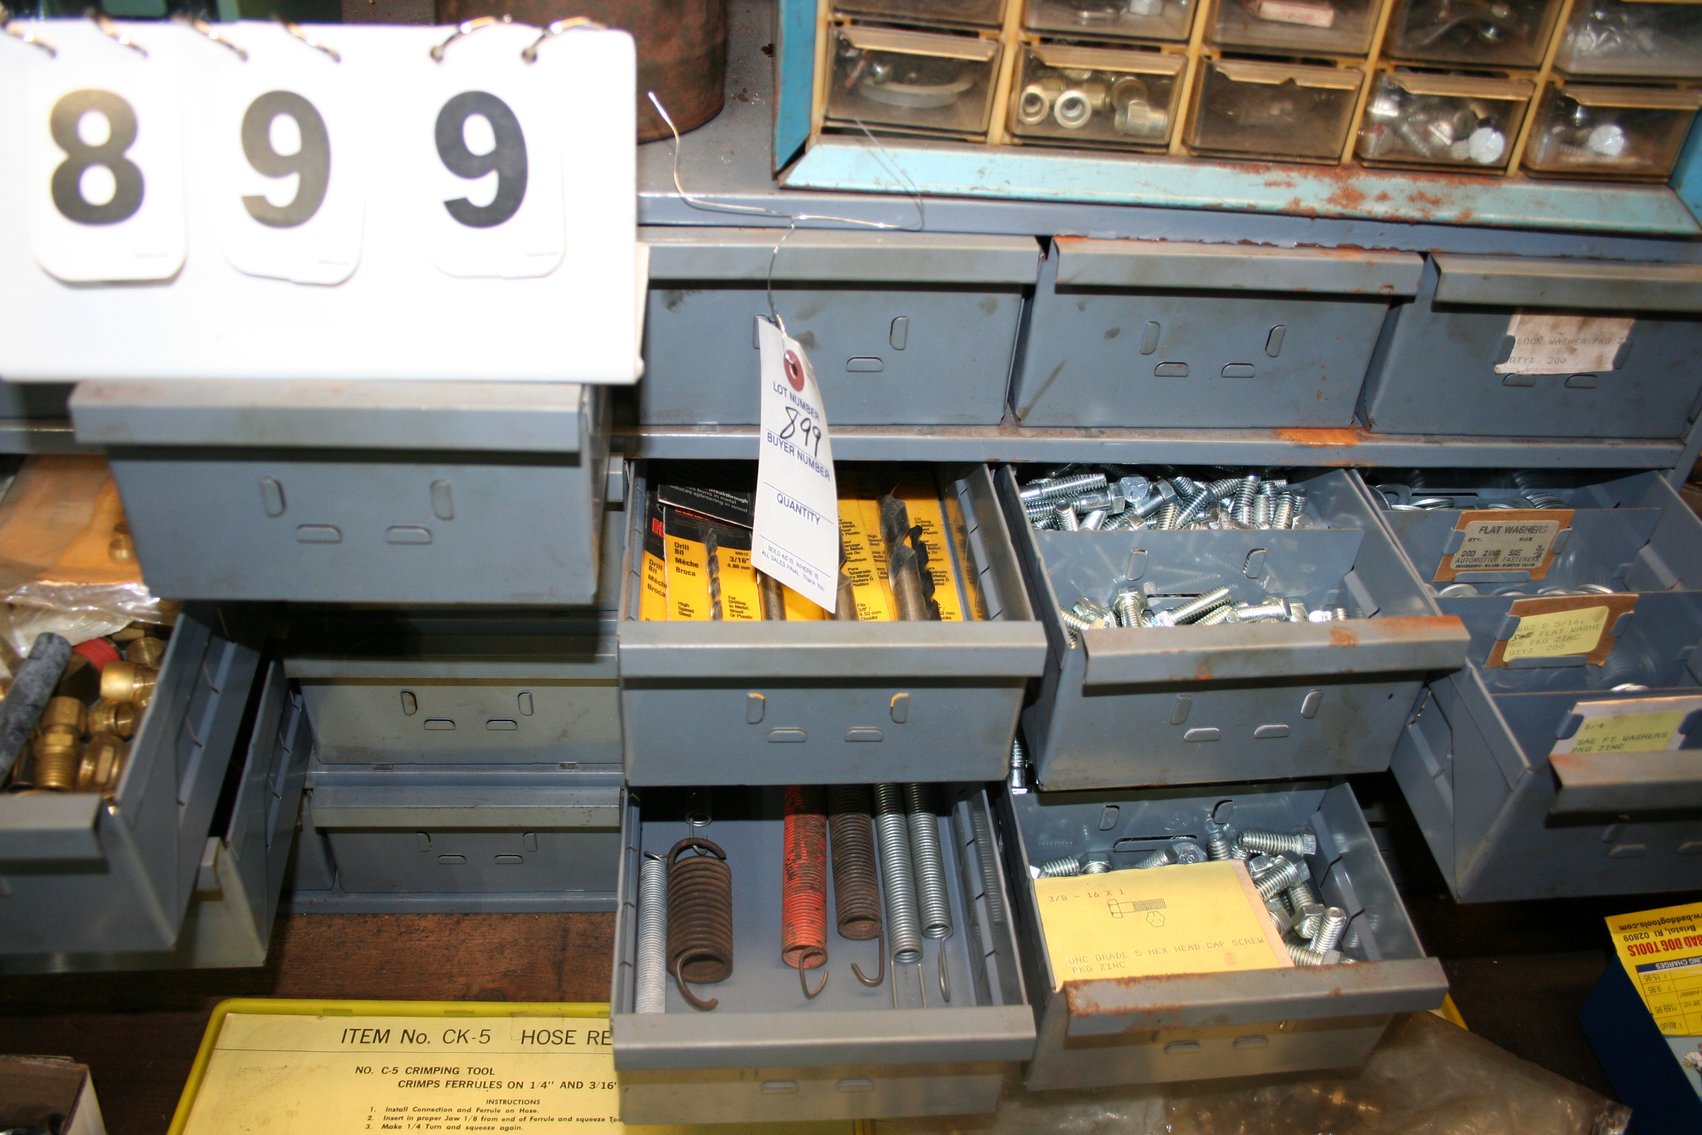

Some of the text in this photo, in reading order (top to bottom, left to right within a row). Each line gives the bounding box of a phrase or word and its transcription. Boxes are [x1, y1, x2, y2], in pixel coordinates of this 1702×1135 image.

[50, 88, 528, 229] 8 9 9
[1549, 337, 1586, 346] WASHER
[773, 381, 819, 420] LOT NUMBER
[780, 406, 822, 457] 899
[767, 432, 830, 480] BUYER NUMBER
[776, 493, 821, 525] QUANTITY
[1479, 525, 1549, 534] FLAT WASHERS
[674, 542, 690, 551] Drill
[674, 548, 686, 556] Bit
[768, 545, 781, 558] SOLD
[762, 550, 770, 561] ALL
[770, 555, 786, 568] SALES
[648, 559, 663, 571] Drill
[675, 567, 696, 577] Broca
[1622, 732, 1668, 742] WASHERS
[1087, 891, 1100, 899] 16
[1623, 931, 1650, 942] 02809
[1654, 930, 1664, 938] RI
[1095, 952, 1129, 962] GRADE
[1148, 946, 1169, 956] HEX
[1174, 943, 1201, 953] HEAD
[1207, 940, 1225, 950] CAP
[1231, 936, 1265, 946] SCREW
[1627, 941, 1661, 957] TOOLS
[1661, 939, 1684, 952] DOG
[1072, 962, 1127, 974] PKG ZINC
[1655, 957, 1688, 970] CHARGES
[341, 1028, 612, 1046] ITEM No. CK-5 HOSE RE
[355, 1066, 495, 1076] NO. C-5 CRIMPING TOOL
[398, 1079, 440, 1089] CRIMPS
[444, 1080, 503, 1090] FERRULES
[507, 1081, 524, 1090] ON
[559, 1080, 584, 1090] AND
[412, 1106, 454, 1114] Connection
[476, 1107, 501, 1115] Ferrule
[416, 1116, 442, 1124] proper
[463, 1115, 478, 1123] 1/8
[529, 1115, 555, 1123] Ferrule
[558, 1115, 573, 1123] and
[575, 1116, 606, 1124] squeeze
[381, 1123, 403, 1131] Make
[407, 1123, 421, 1131] 1/4
[425, 1123, 443, 1131] Turn
[446, 1123, 462, 1131] and
[465, 1124, 496, 1133] squeeze
[499, 1124, 523, 1133] again.
